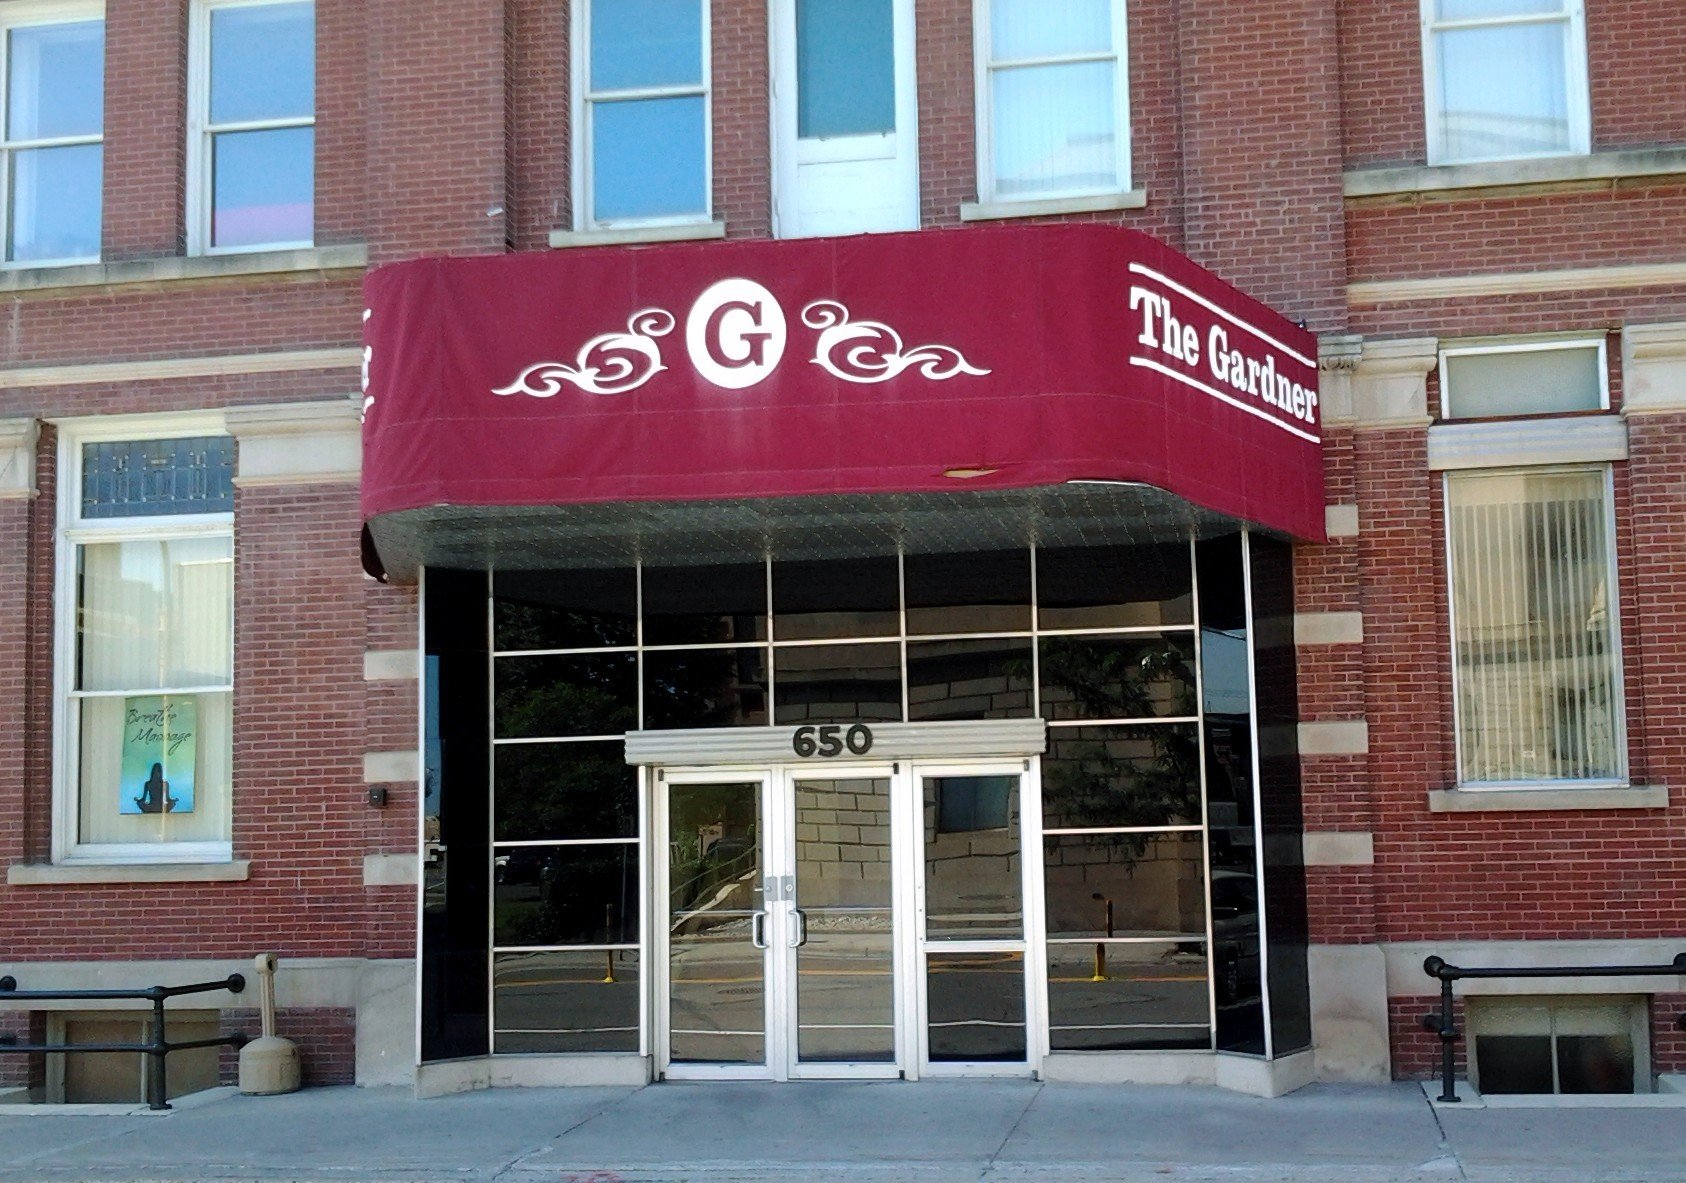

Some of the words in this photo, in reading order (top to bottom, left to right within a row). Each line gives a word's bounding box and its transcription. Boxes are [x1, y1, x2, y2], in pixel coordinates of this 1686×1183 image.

[704, 300, 773, 369] G
[1129, 285, 1200, 367] The
[1208, 324, 1318, 424] Gardner
[793, 723, 873, 757] 650
